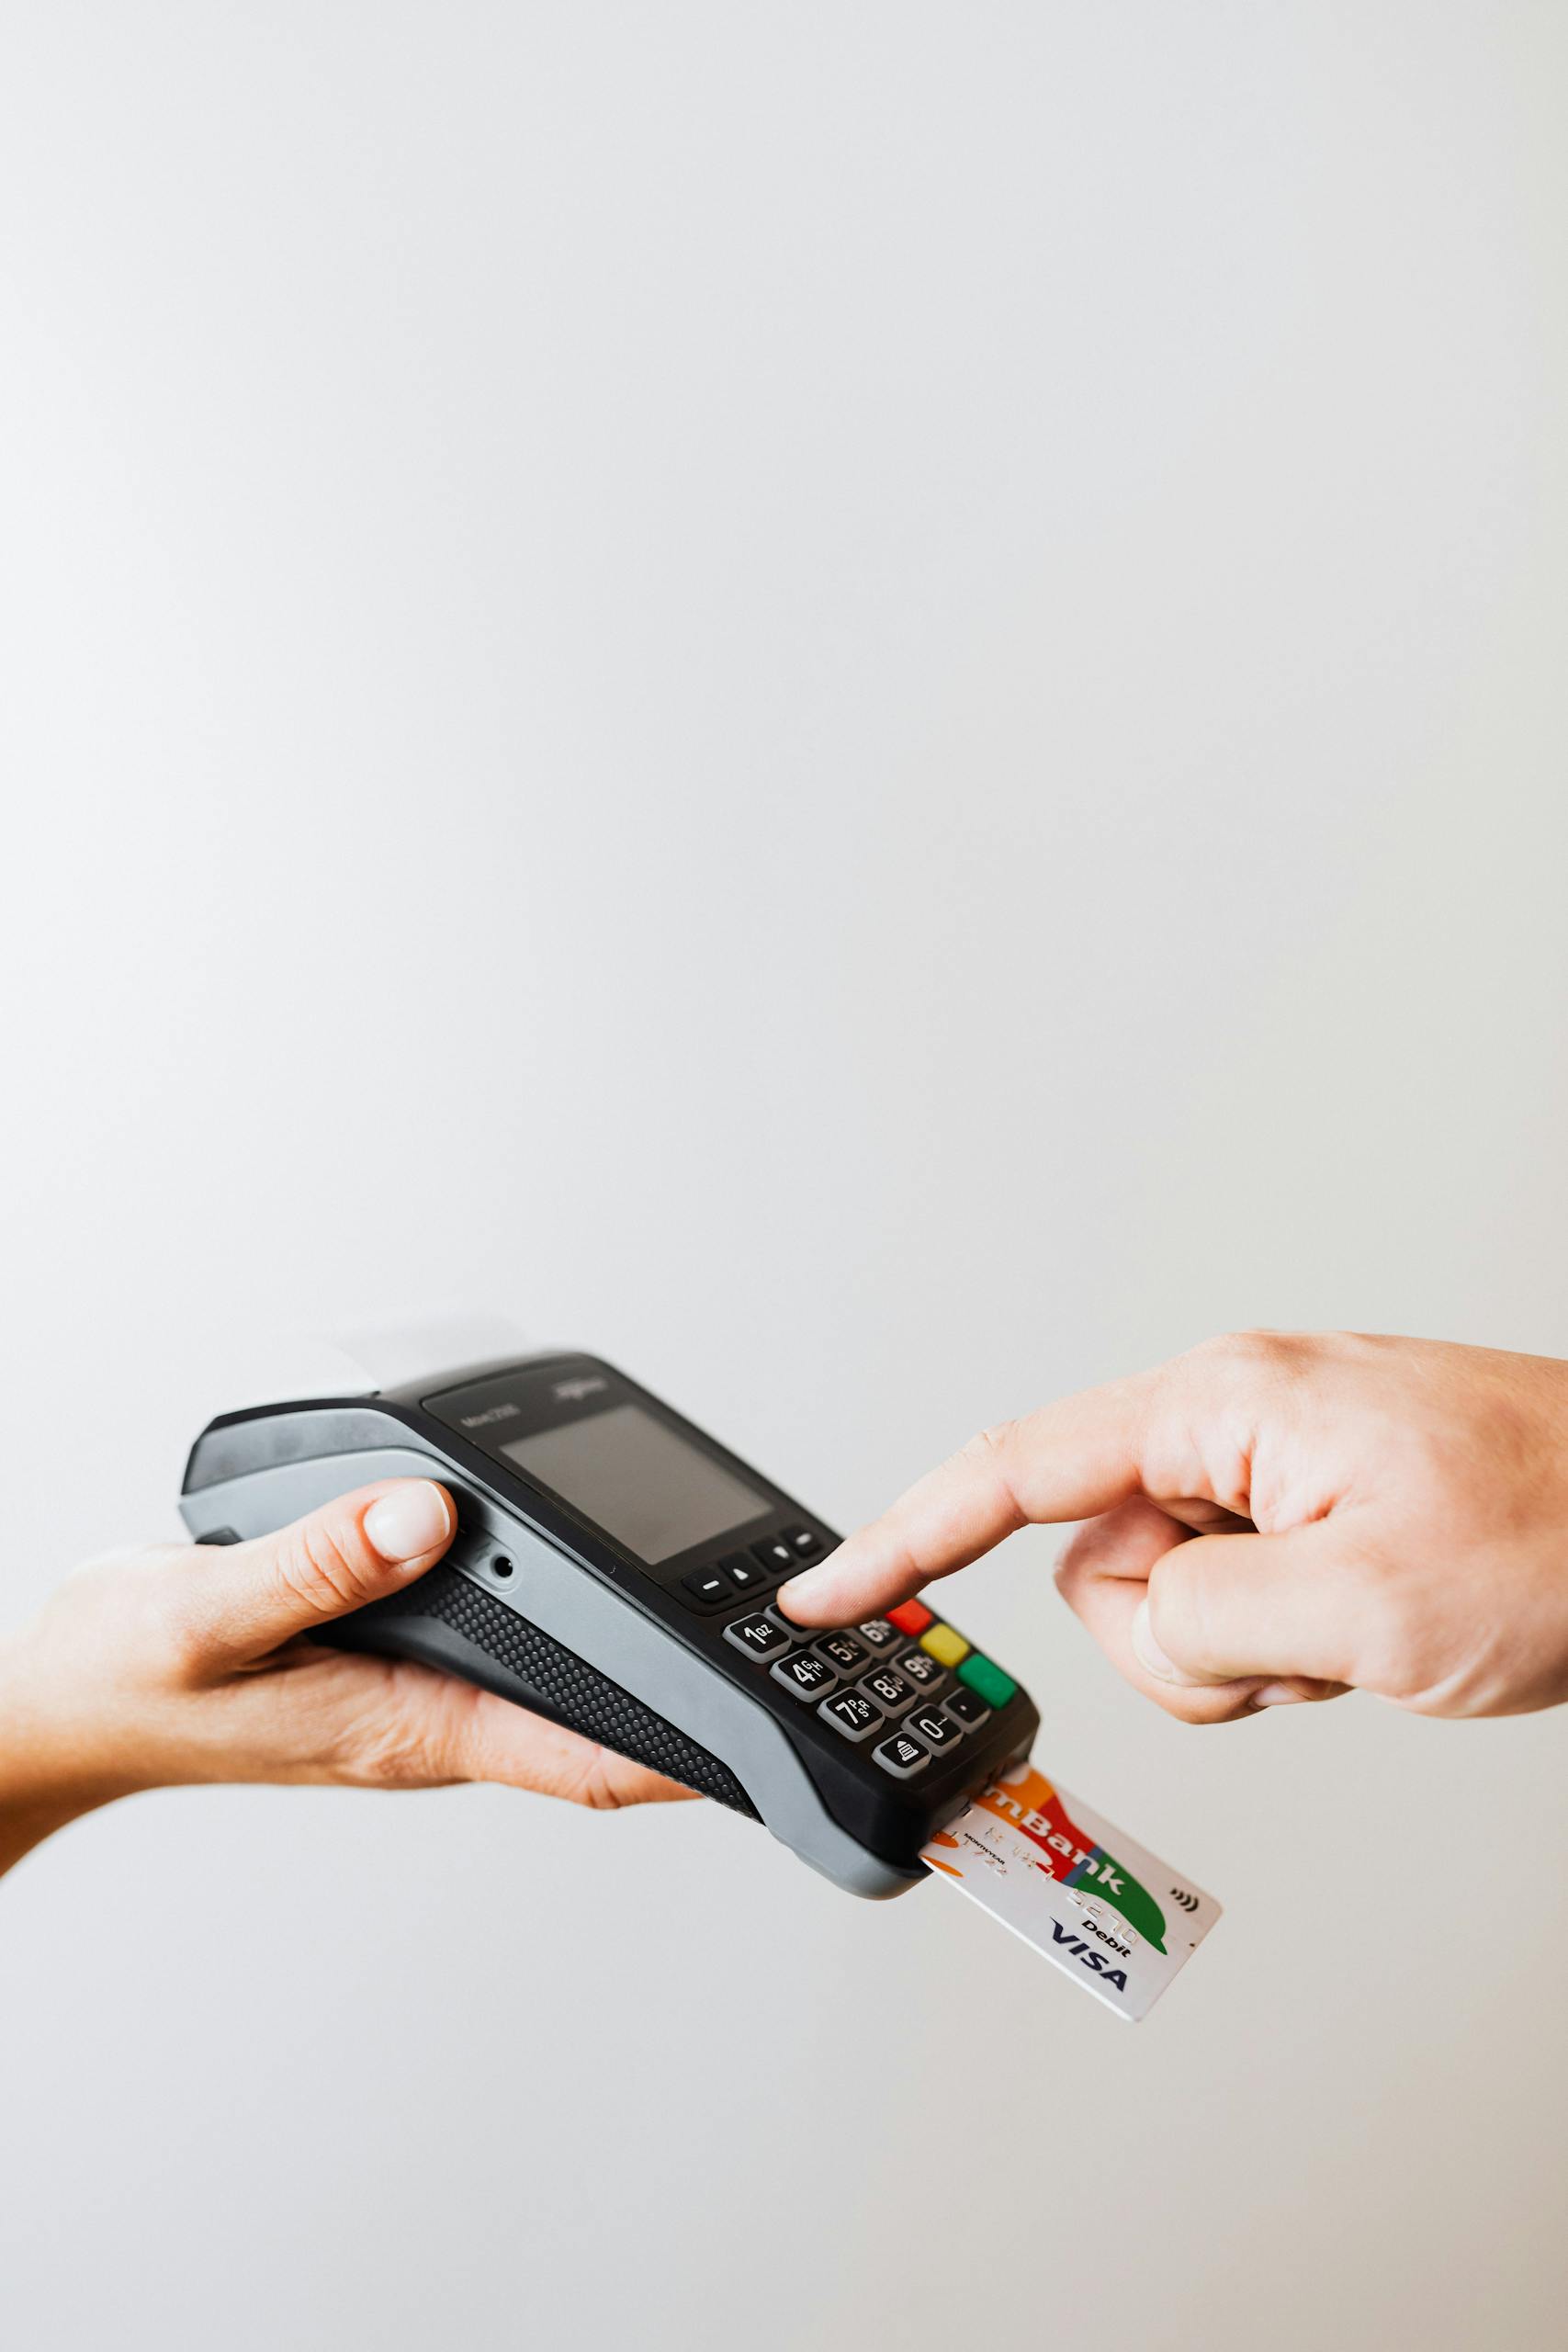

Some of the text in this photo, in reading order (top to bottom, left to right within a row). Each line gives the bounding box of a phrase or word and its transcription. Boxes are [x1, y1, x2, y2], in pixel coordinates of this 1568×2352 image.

[860, 1620, 884, 1643] 6
[828, 1642, 853, 1661] 5
[792, 1663, 816, 1682] 4
[904, 1659, 929, 1679] 9
[873, 1679, 897, 1699] 8
[835, 1701, 859, 1724] 7
[985, 1786, 1125, 1896] mBank
[1081, 1919, 1132, 1959] Debit
[1049, 1916, 1128, 1993] VISA
